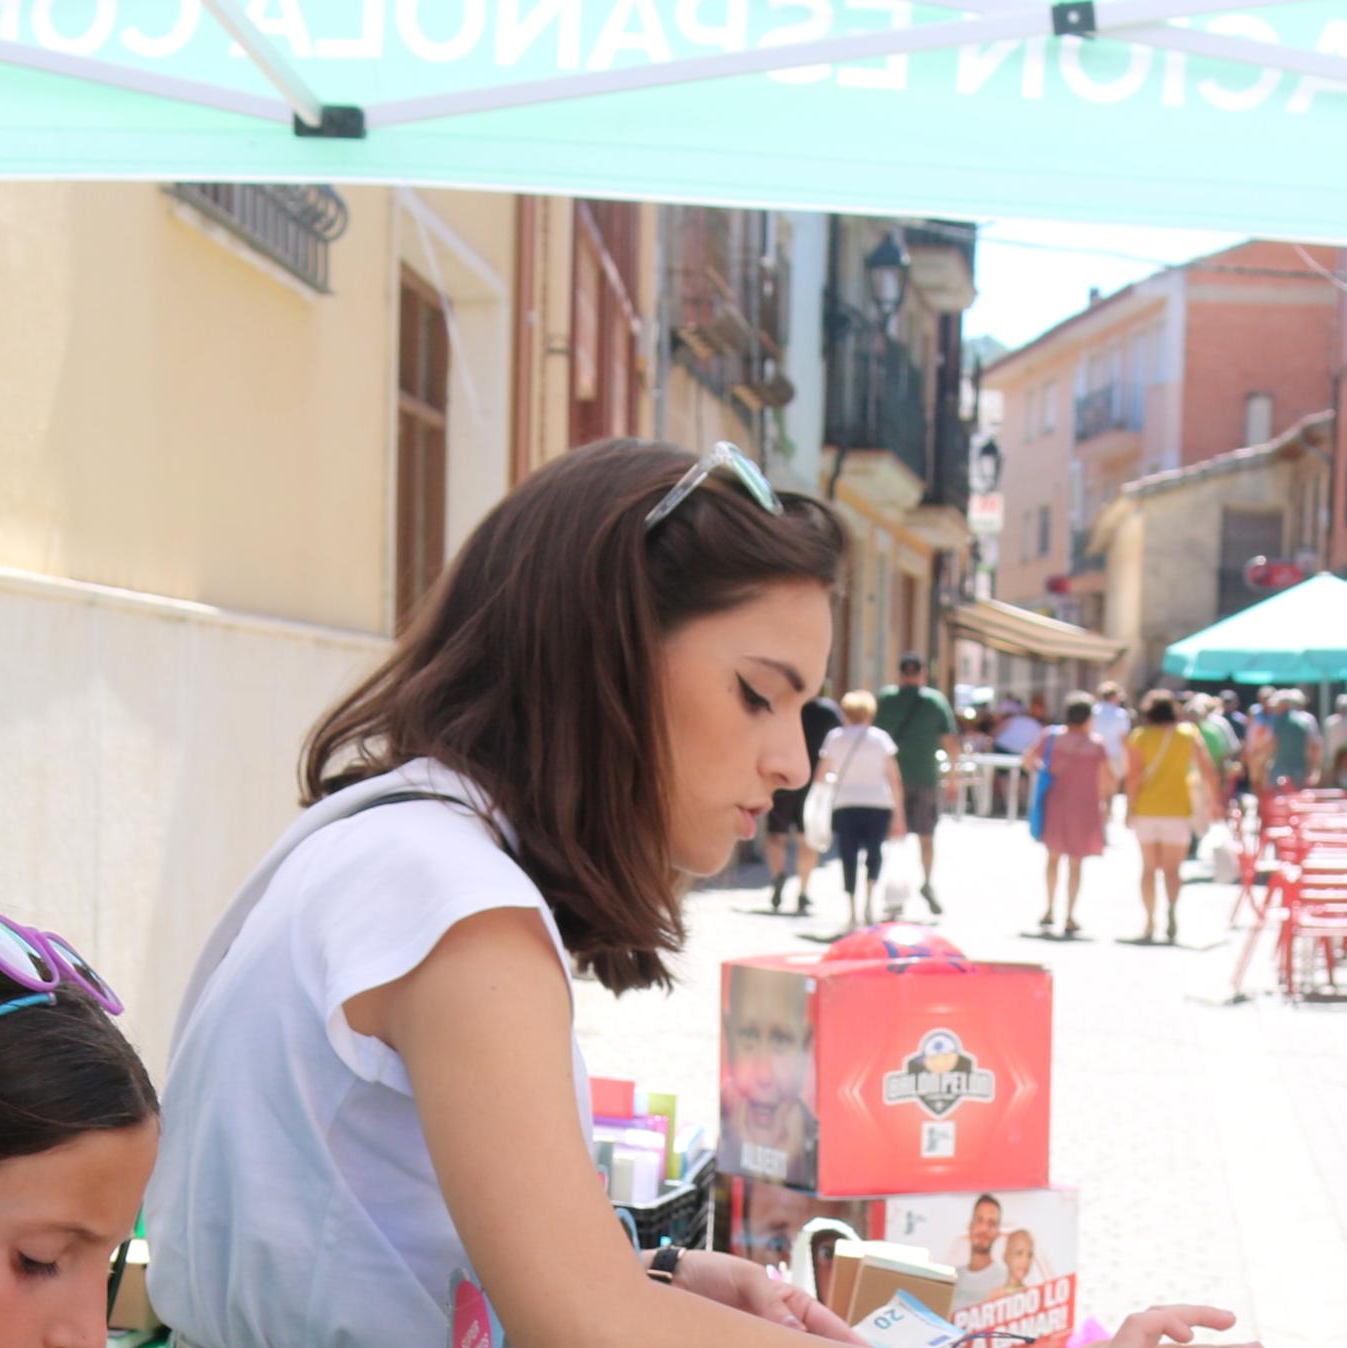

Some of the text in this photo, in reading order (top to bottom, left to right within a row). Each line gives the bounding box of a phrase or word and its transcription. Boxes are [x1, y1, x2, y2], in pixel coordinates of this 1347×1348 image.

[874, 1308, 905, 1331] 20
[954, 1278, 1070, 1332] PARTIDO LO
